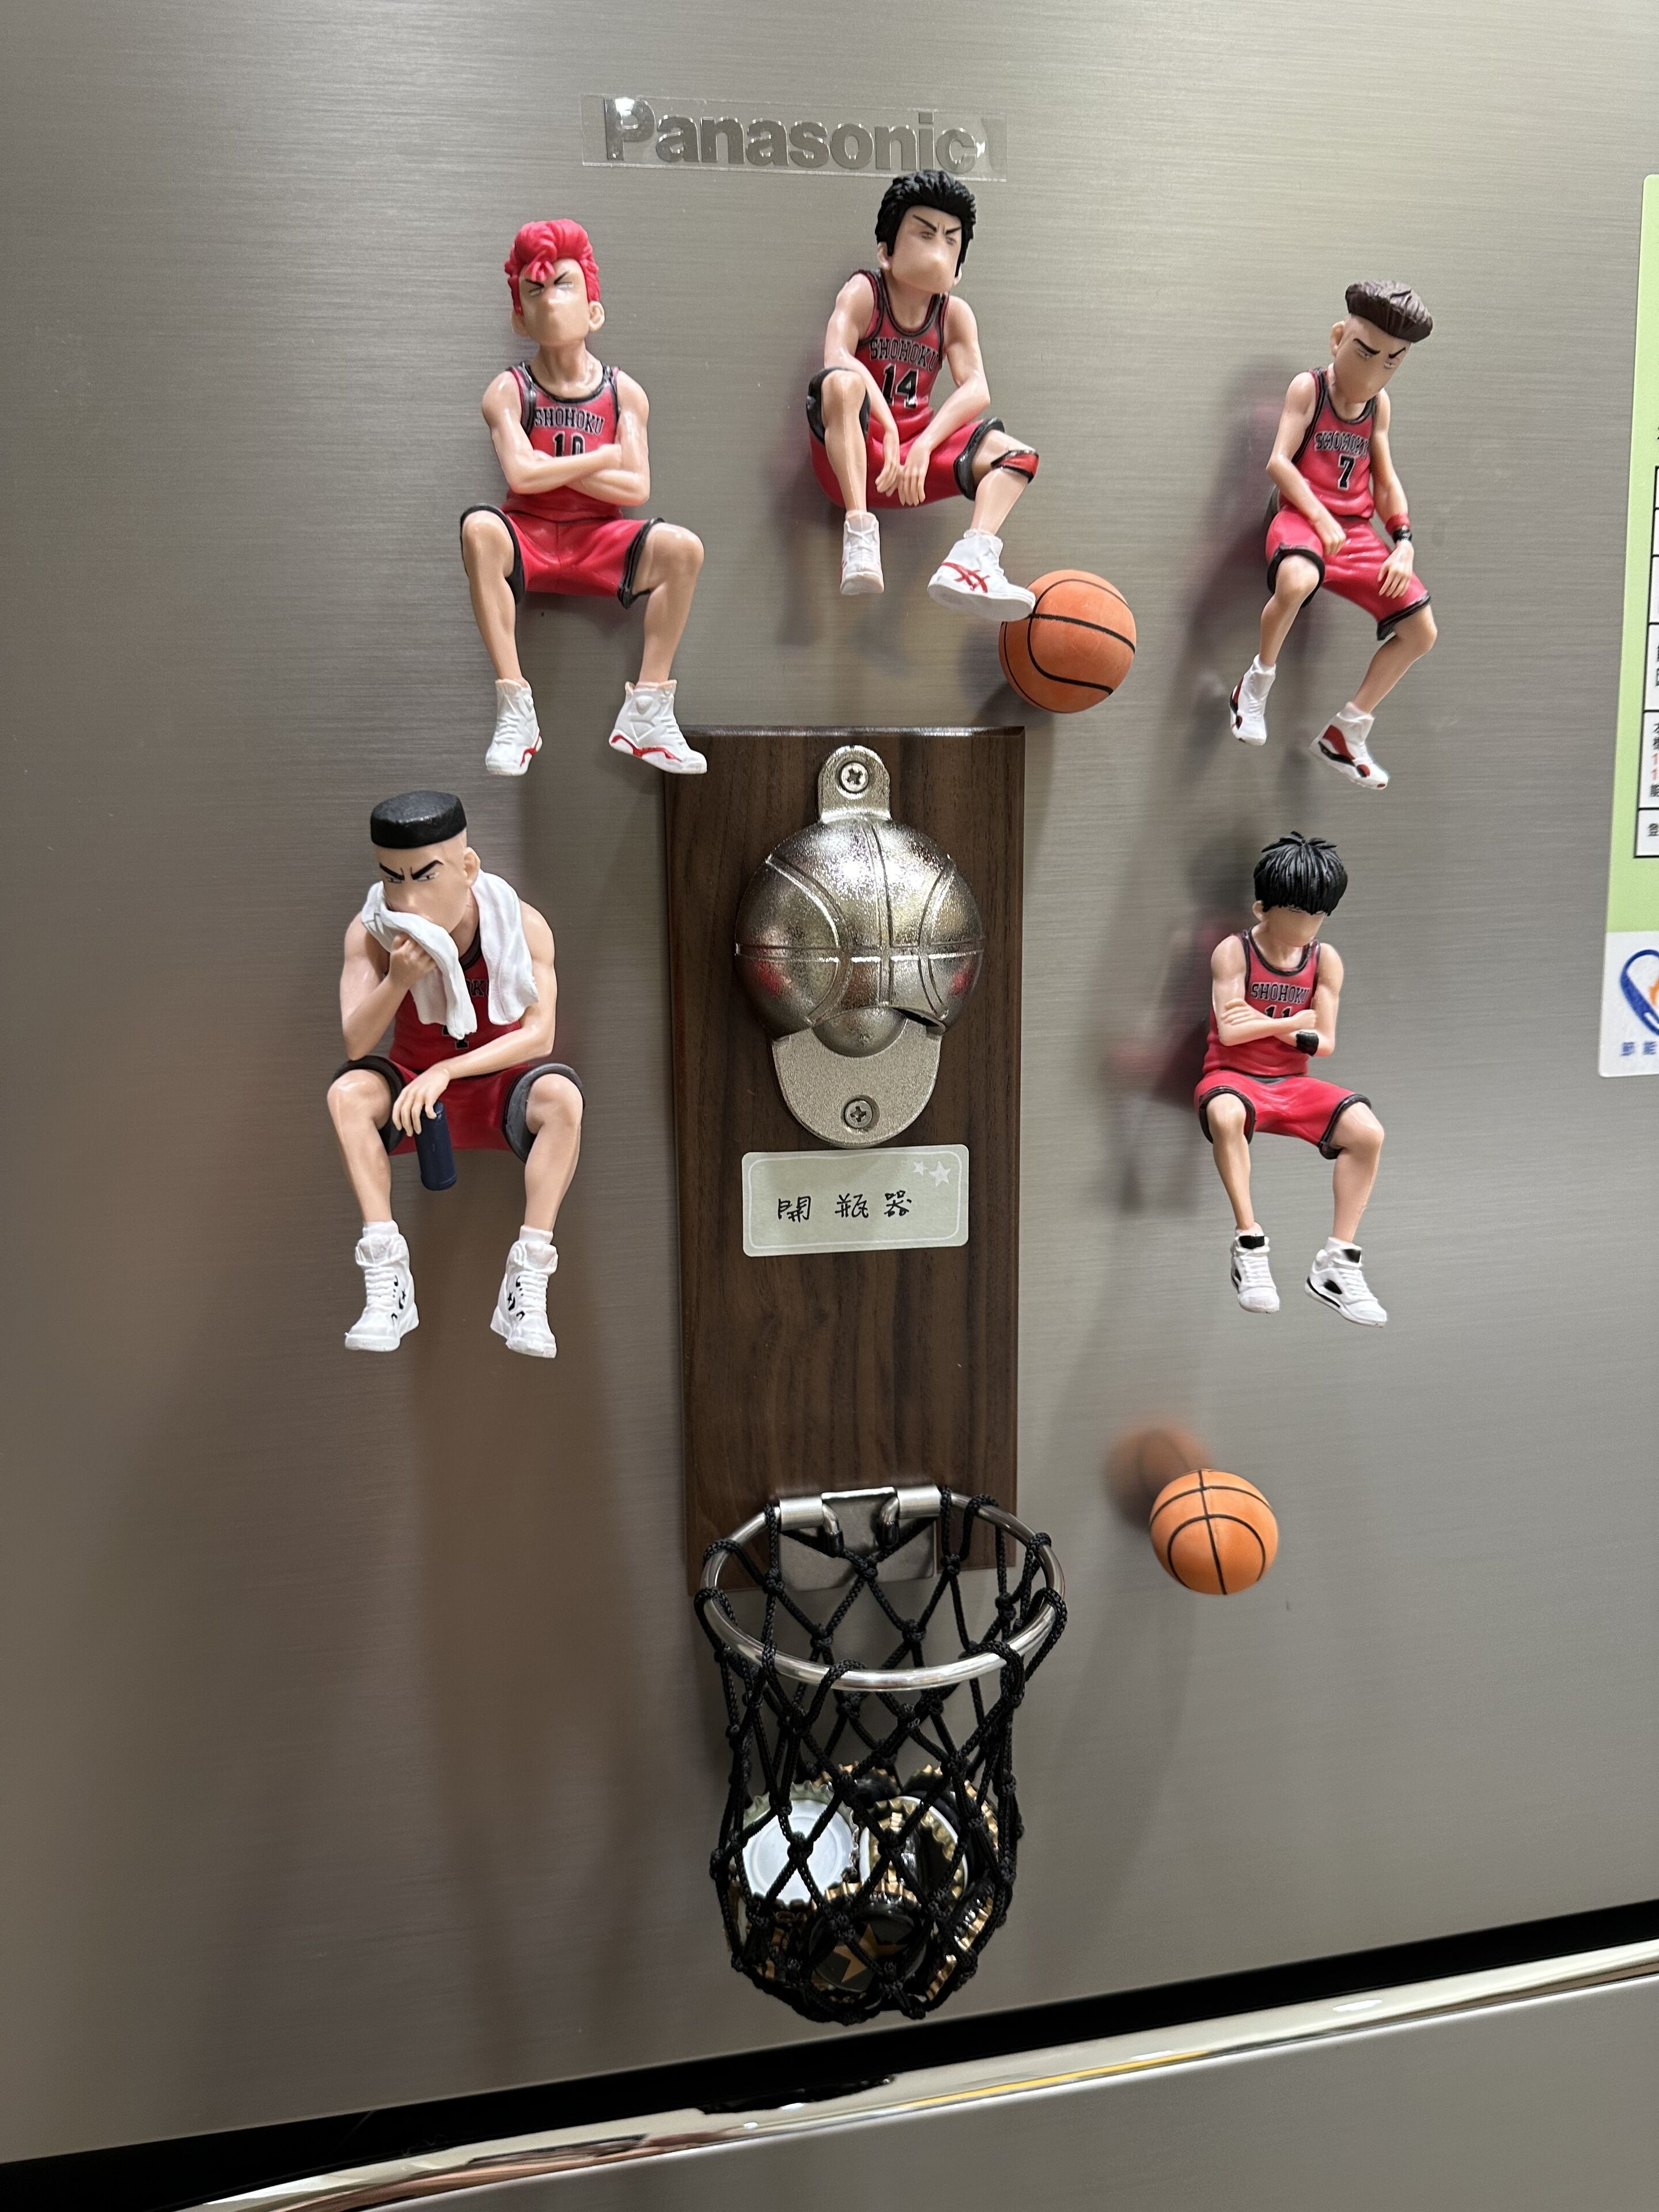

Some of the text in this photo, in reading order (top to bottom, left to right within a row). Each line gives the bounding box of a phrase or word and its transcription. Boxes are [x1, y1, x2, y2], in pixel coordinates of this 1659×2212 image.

[603, 97, 978, 173] Panasonic
[869, 336, 940, 372] SHOHOKU
[882, 363, 919, 409] 14
[535, 406, 605, 436] SHOHOKU
[1338, 453, 1355, 491] 7
[1251, 982, 1310, 1004] SHOHOKU
[777, 1190, 912, 1222] 開瓶器
